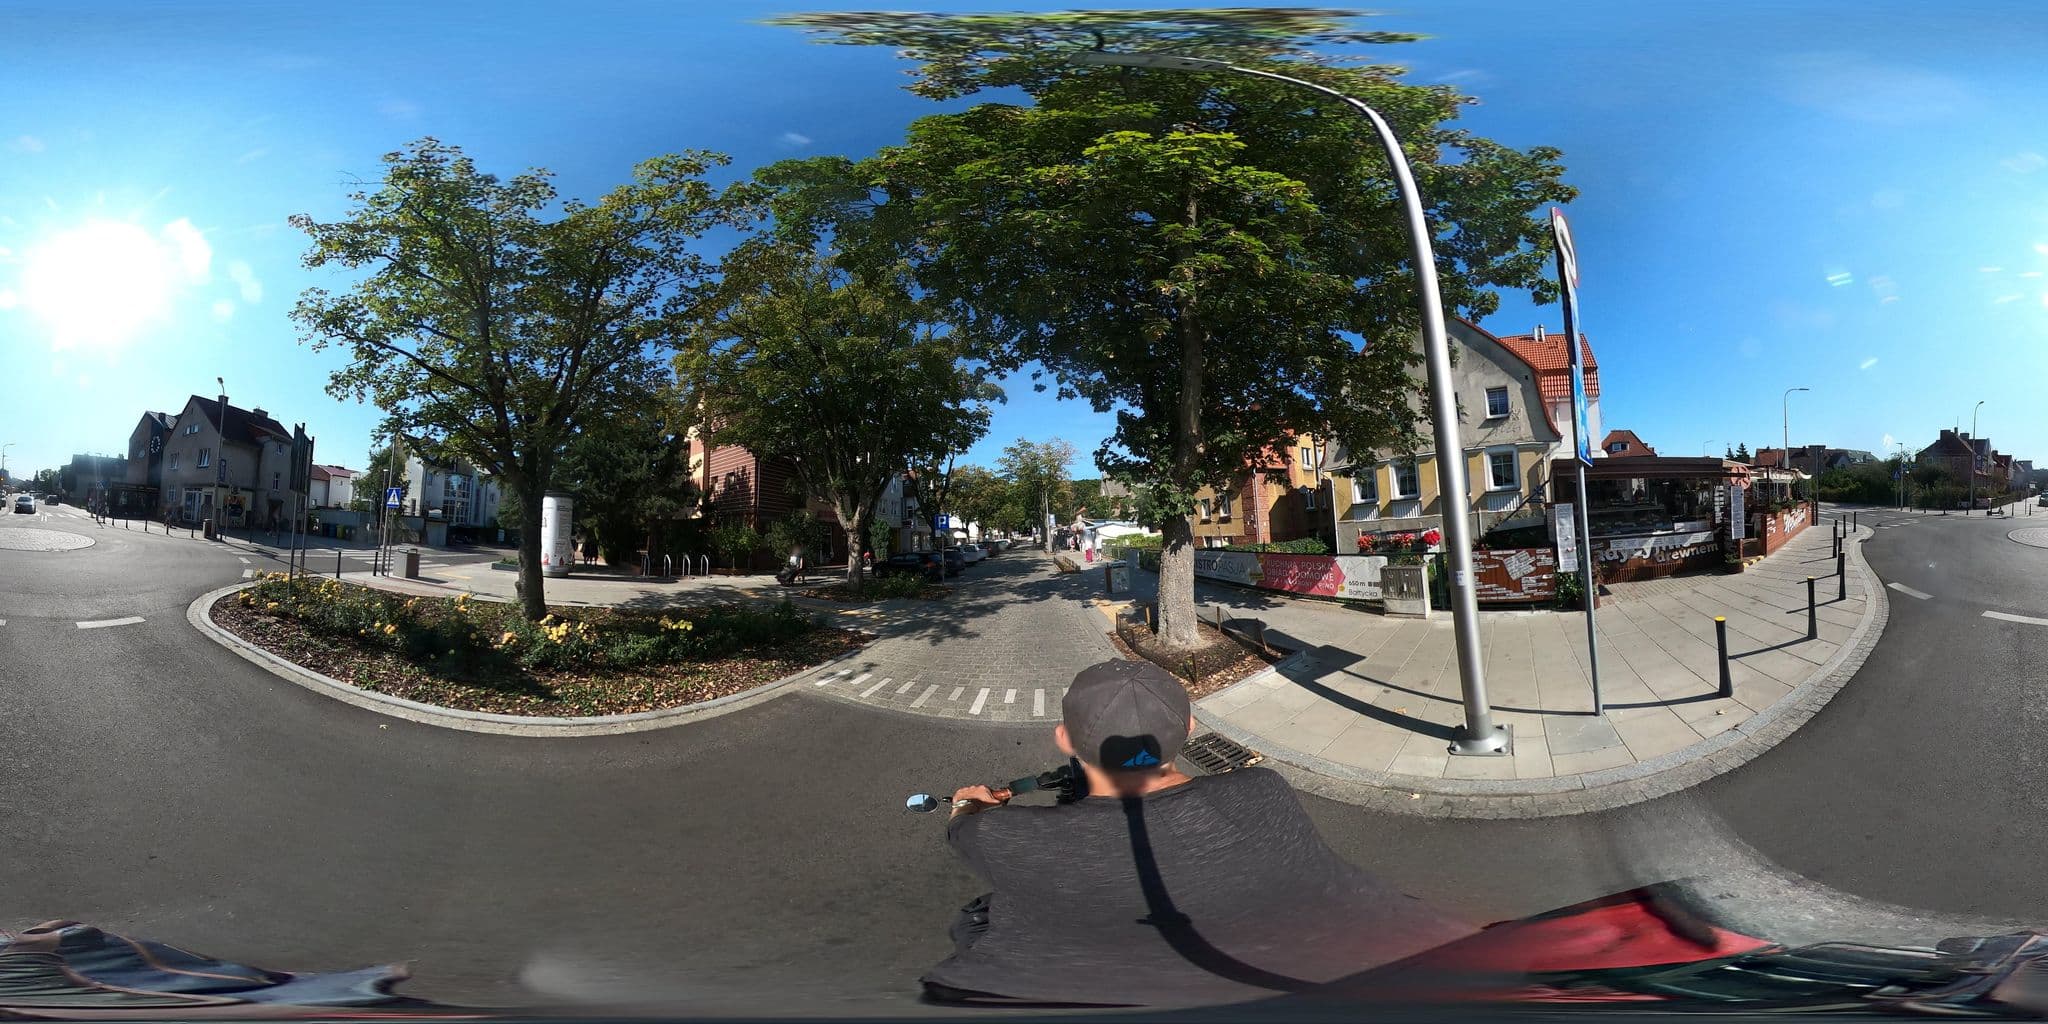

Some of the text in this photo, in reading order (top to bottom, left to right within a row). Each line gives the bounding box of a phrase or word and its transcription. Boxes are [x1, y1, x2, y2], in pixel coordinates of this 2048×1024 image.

[938, 515, 947, 528] P
[1301, 561, 1332, 571] POLSKA
[1296, 570, 1335, 582] DOMOWE
